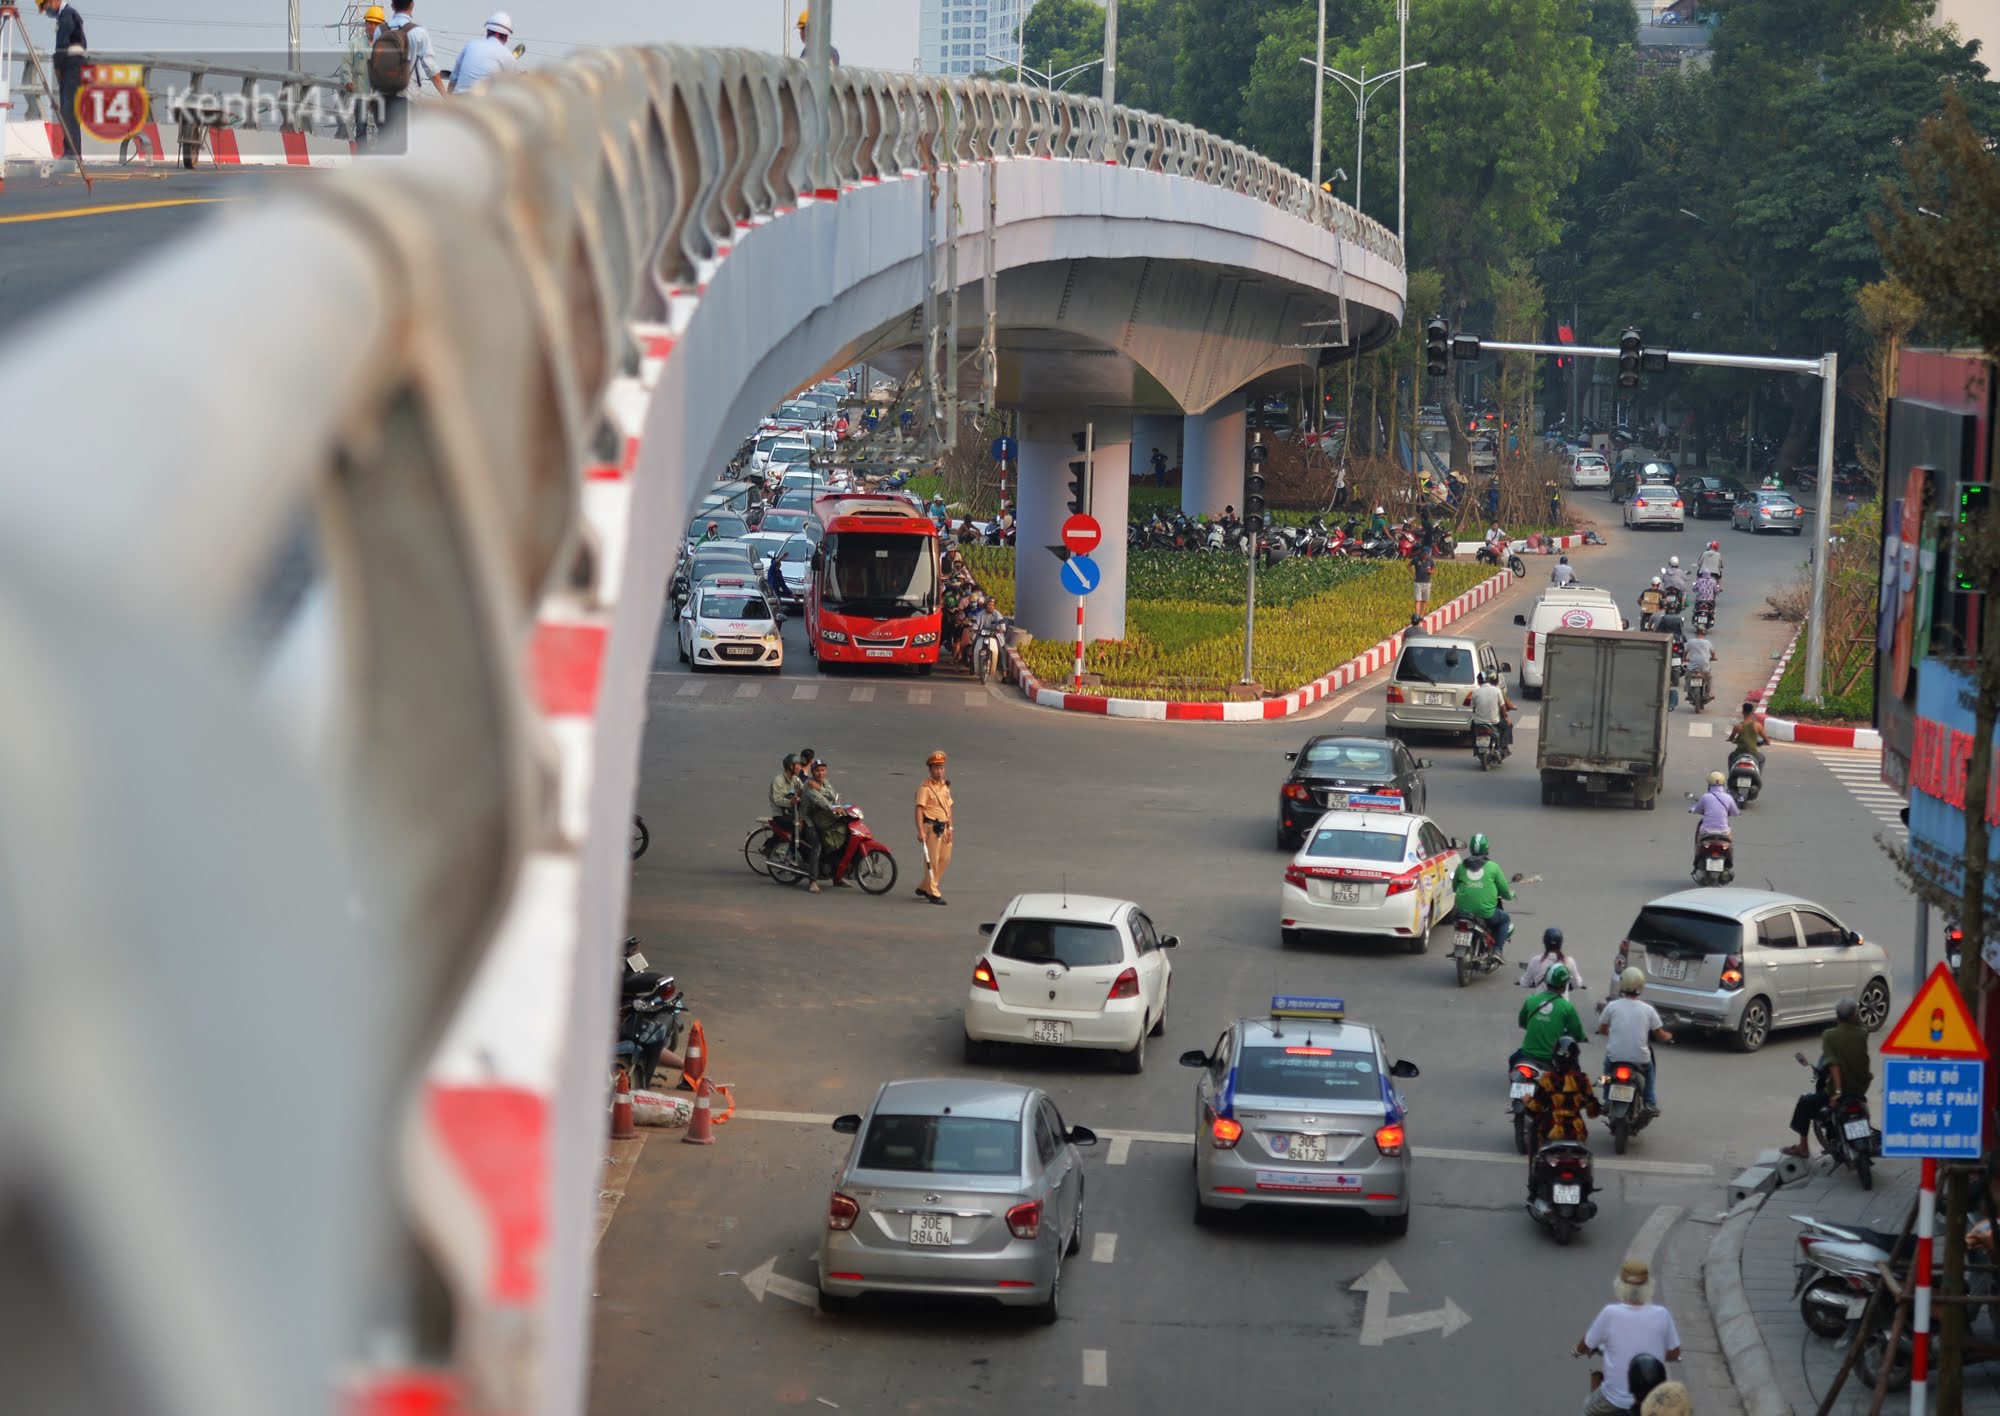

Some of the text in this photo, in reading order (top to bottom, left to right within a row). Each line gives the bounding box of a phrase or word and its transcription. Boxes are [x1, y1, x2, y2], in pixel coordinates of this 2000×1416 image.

[1331, 801, 1347, 809] 4710
[1311, 867, 1339, 876] HANOI
[1338, 883, 1353, 892] 30E
[1332, 891, 1358, 901] 974.57
[1041, 1022, 1058, 1032] 30E
[1910, 1109, 1938, 1127] CHÚ
[1298, 1136, 1317, 1148] 30E
[1290, 1148, 1325, 1160] 641.79
[921, 1217, 942, 1230] 30E
[911, 1231, 950, 1245] 384.04
